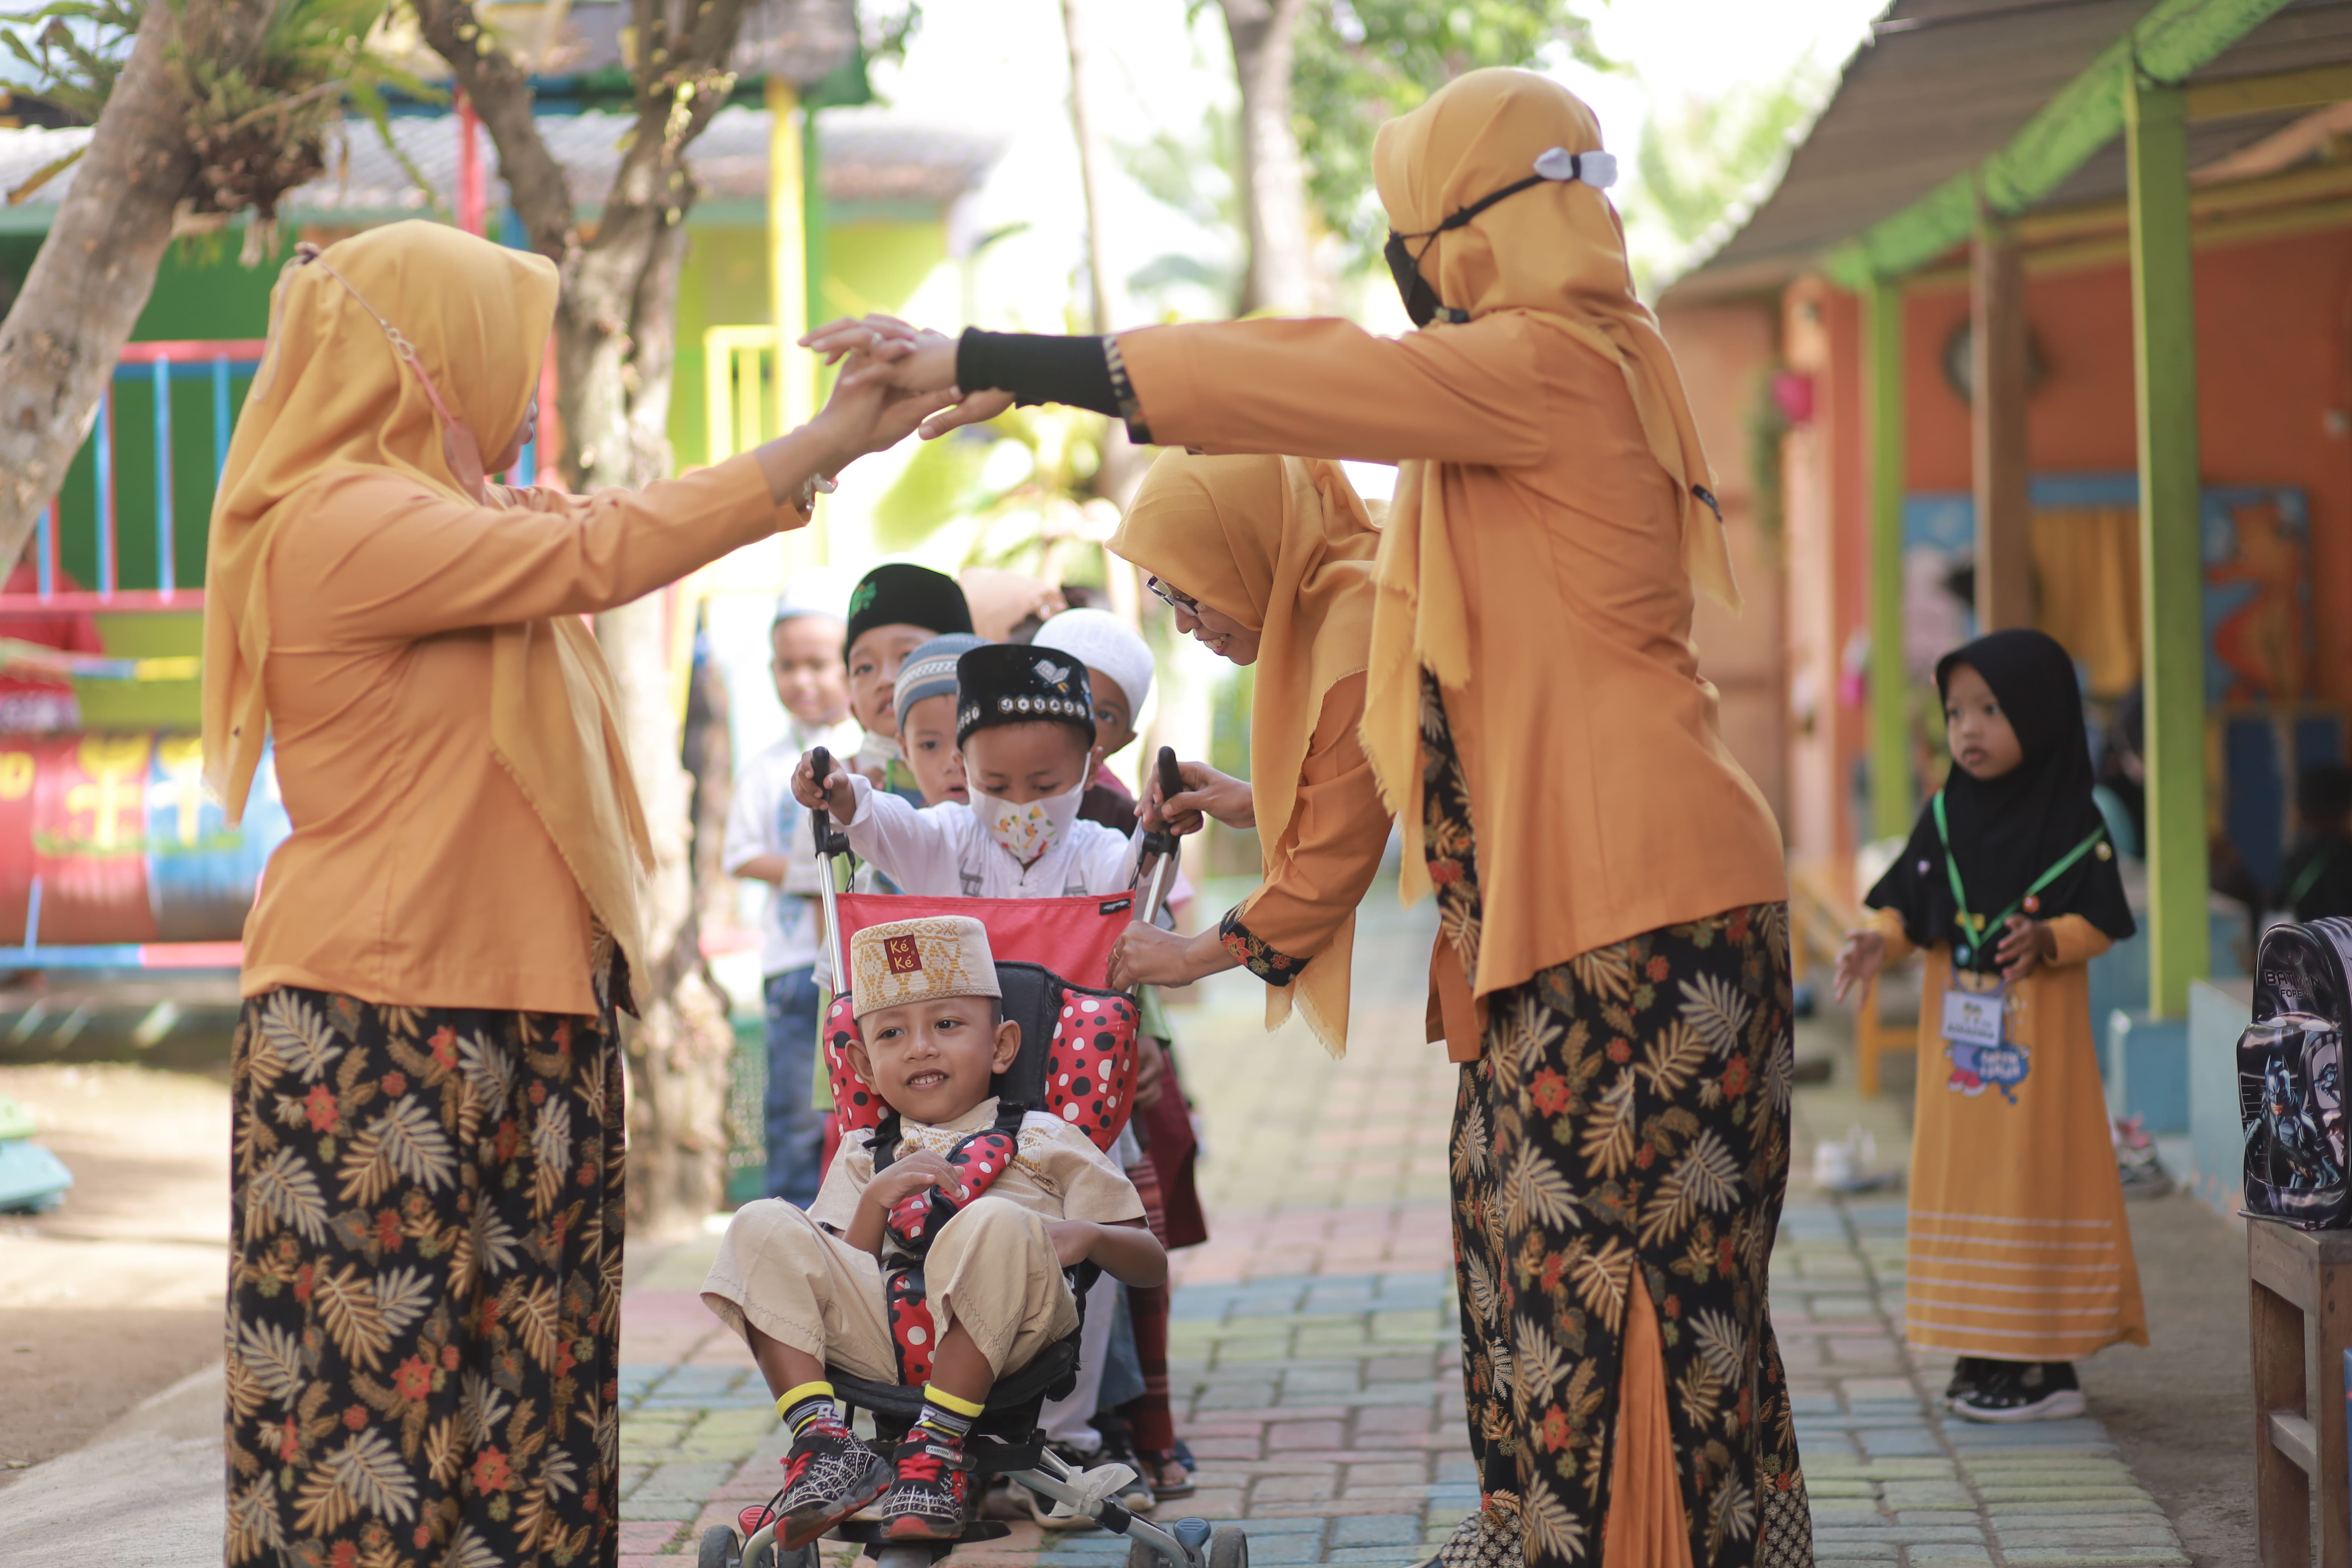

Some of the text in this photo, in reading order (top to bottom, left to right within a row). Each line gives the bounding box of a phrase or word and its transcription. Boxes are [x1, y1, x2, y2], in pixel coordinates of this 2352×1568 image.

[890, 939, 909, 954] Ké
[894, 955, 914, 970] Ké
[2264, 970, 2322, 991] BATMAN
[2280, 989, 2314, 998] FOREV
[926, 1447, 949, 1456] FASHION
